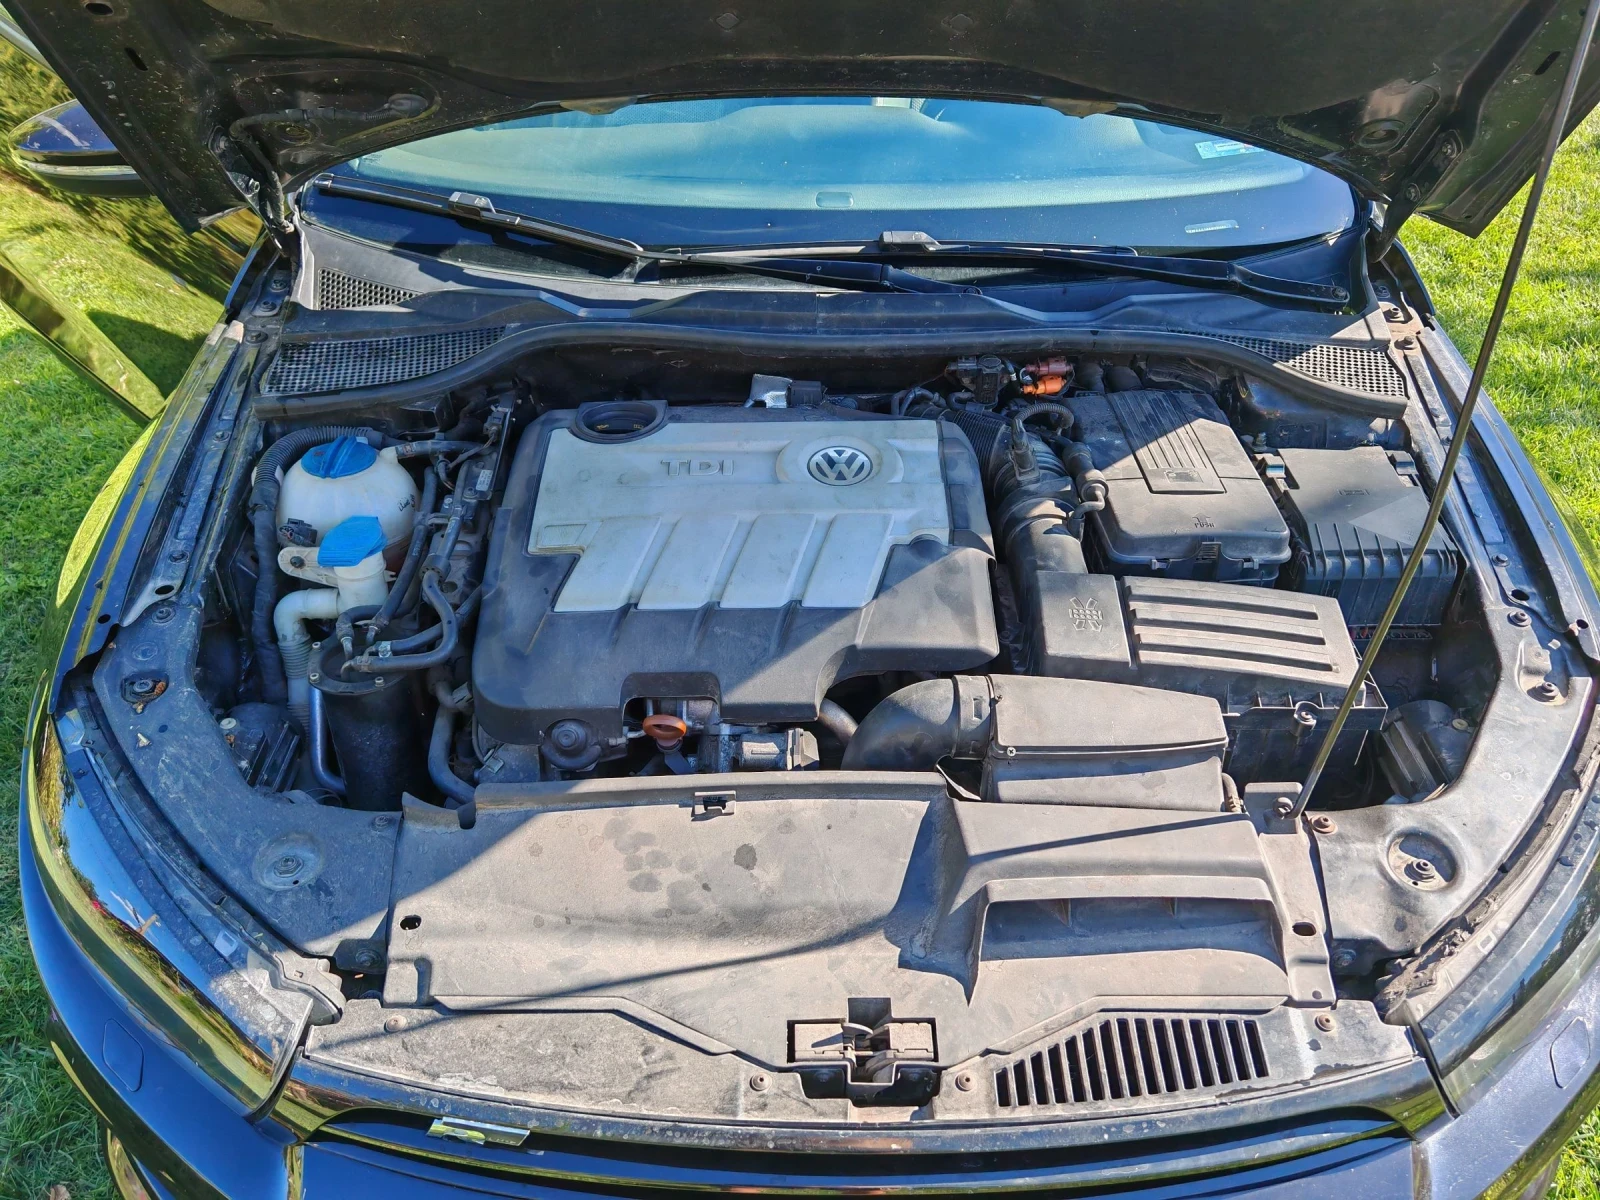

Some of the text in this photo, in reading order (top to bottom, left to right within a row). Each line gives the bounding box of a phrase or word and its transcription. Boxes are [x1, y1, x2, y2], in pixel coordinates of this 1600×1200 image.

[660, 458, 735, 477] TDI
[808, 446, 873, 486] VW
[1194, 521, 1215, 529] PUSH
